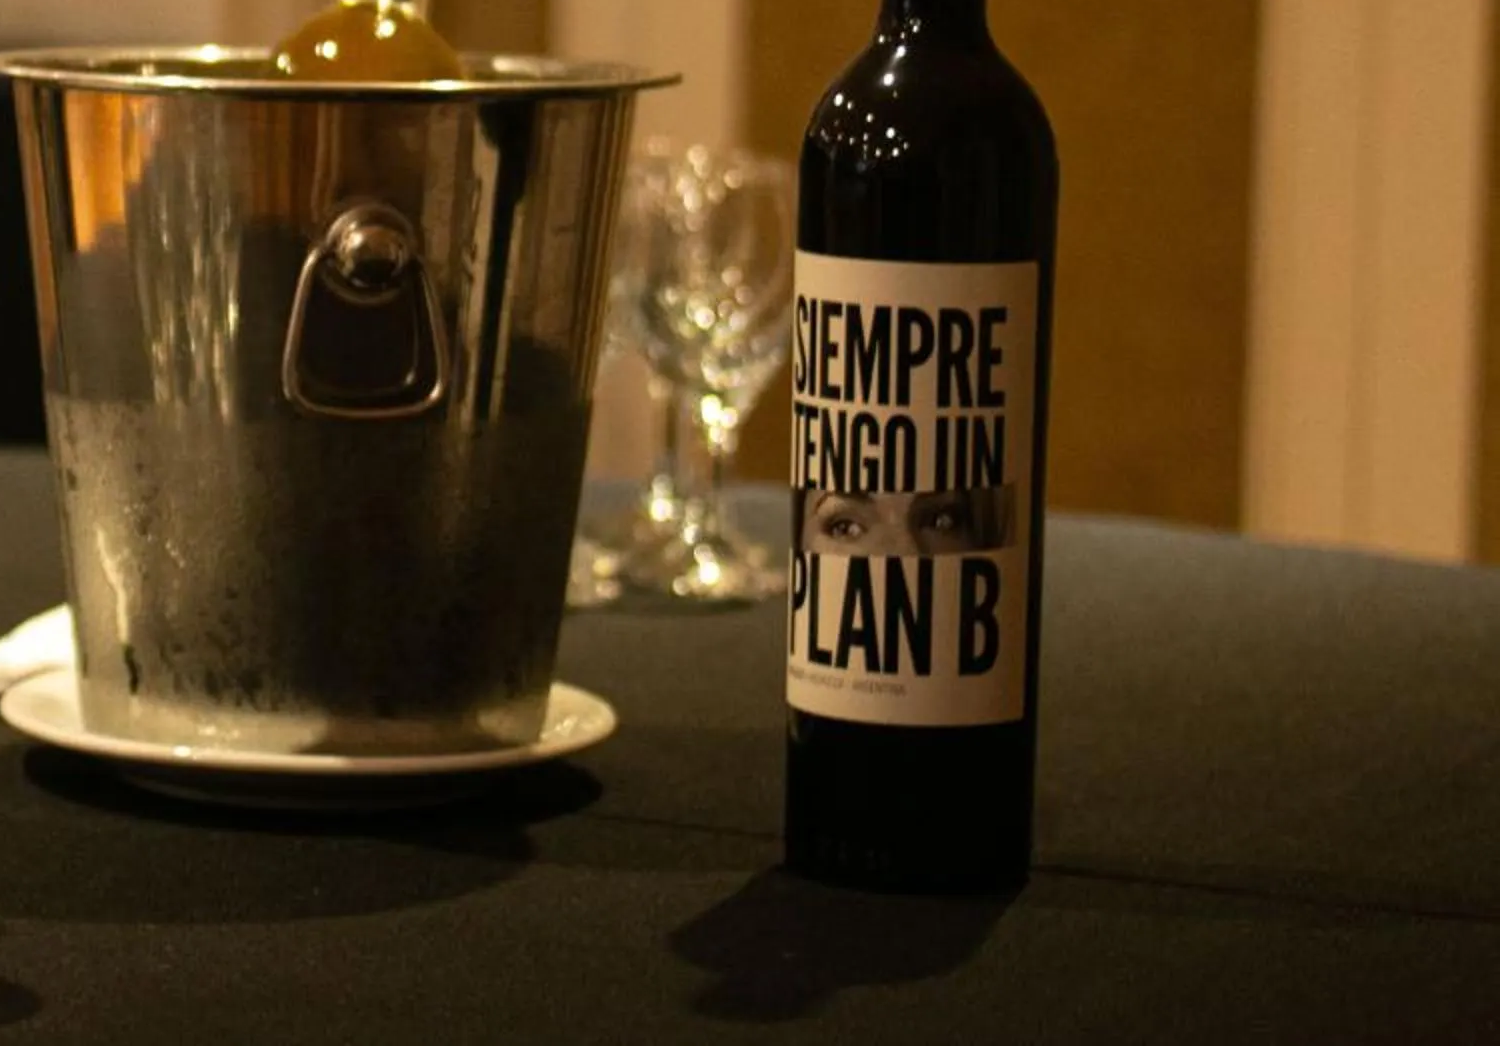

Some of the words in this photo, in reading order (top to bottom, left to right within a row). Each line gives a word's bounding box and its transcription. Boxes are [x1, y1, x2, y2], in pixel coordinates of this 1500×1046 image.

[795, 294, 1007, 408] SIEMPRE
[794, 402, 917, 494] TENGO
[934, 415, 1006, 492] UN
[790, 552, 933, 677] PLAN
[958, 558, 1001, 676] B
